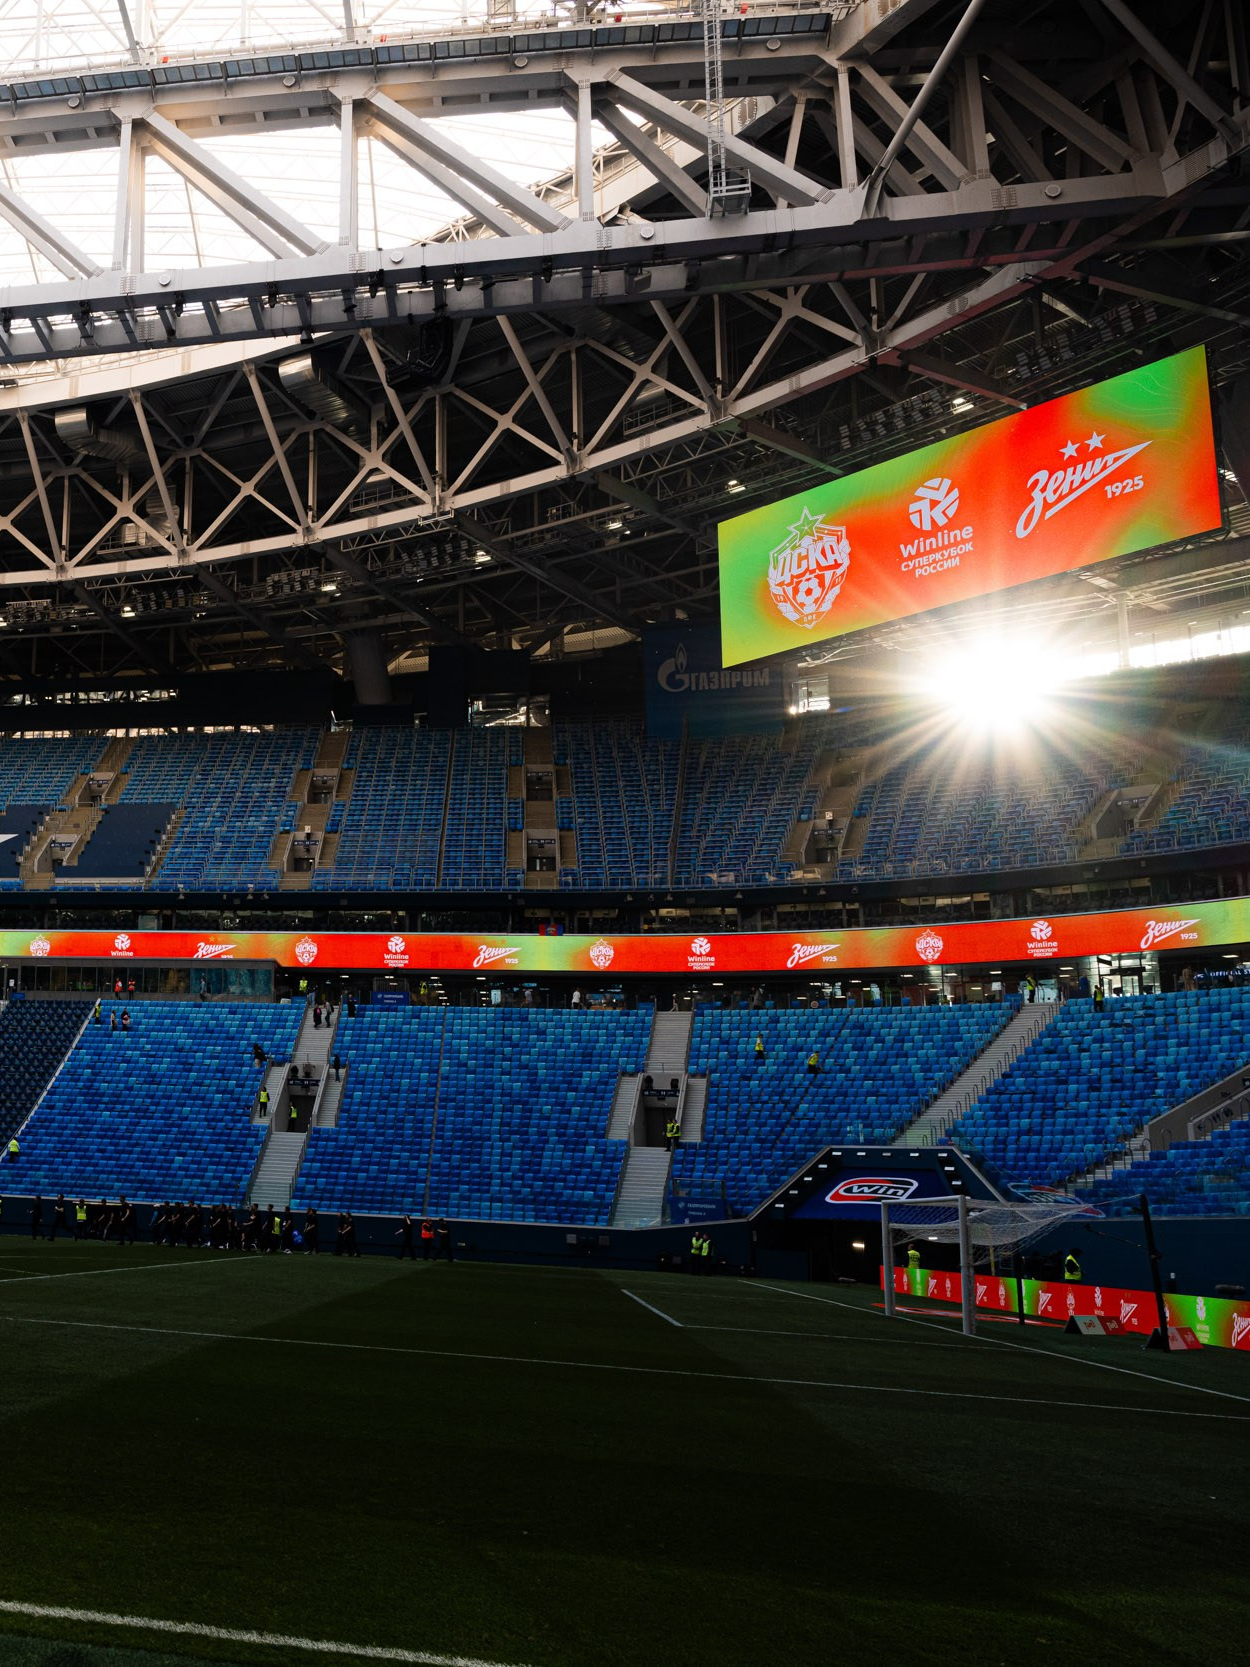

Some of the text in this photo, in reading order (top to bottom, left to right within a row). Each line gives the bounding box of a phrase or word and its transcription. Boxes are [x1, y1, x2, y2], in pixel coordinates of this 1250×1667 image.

[1104, 474, 1144, 499] 1925
[899, 525, 973, 558] Winline
[775, 540, 844, 586] ЦСКА
[901, 541, 974, 571] СУПЕРКУБОК
[915, 556, 960, 578] РОССИИ
[690, 668, 770, 692] ГАЗПРОМ
[1027, 940, 1058, 949] Winline
[1180, 932, 1198, 940] 1925
[850, 1182, 905, 1198] Win
